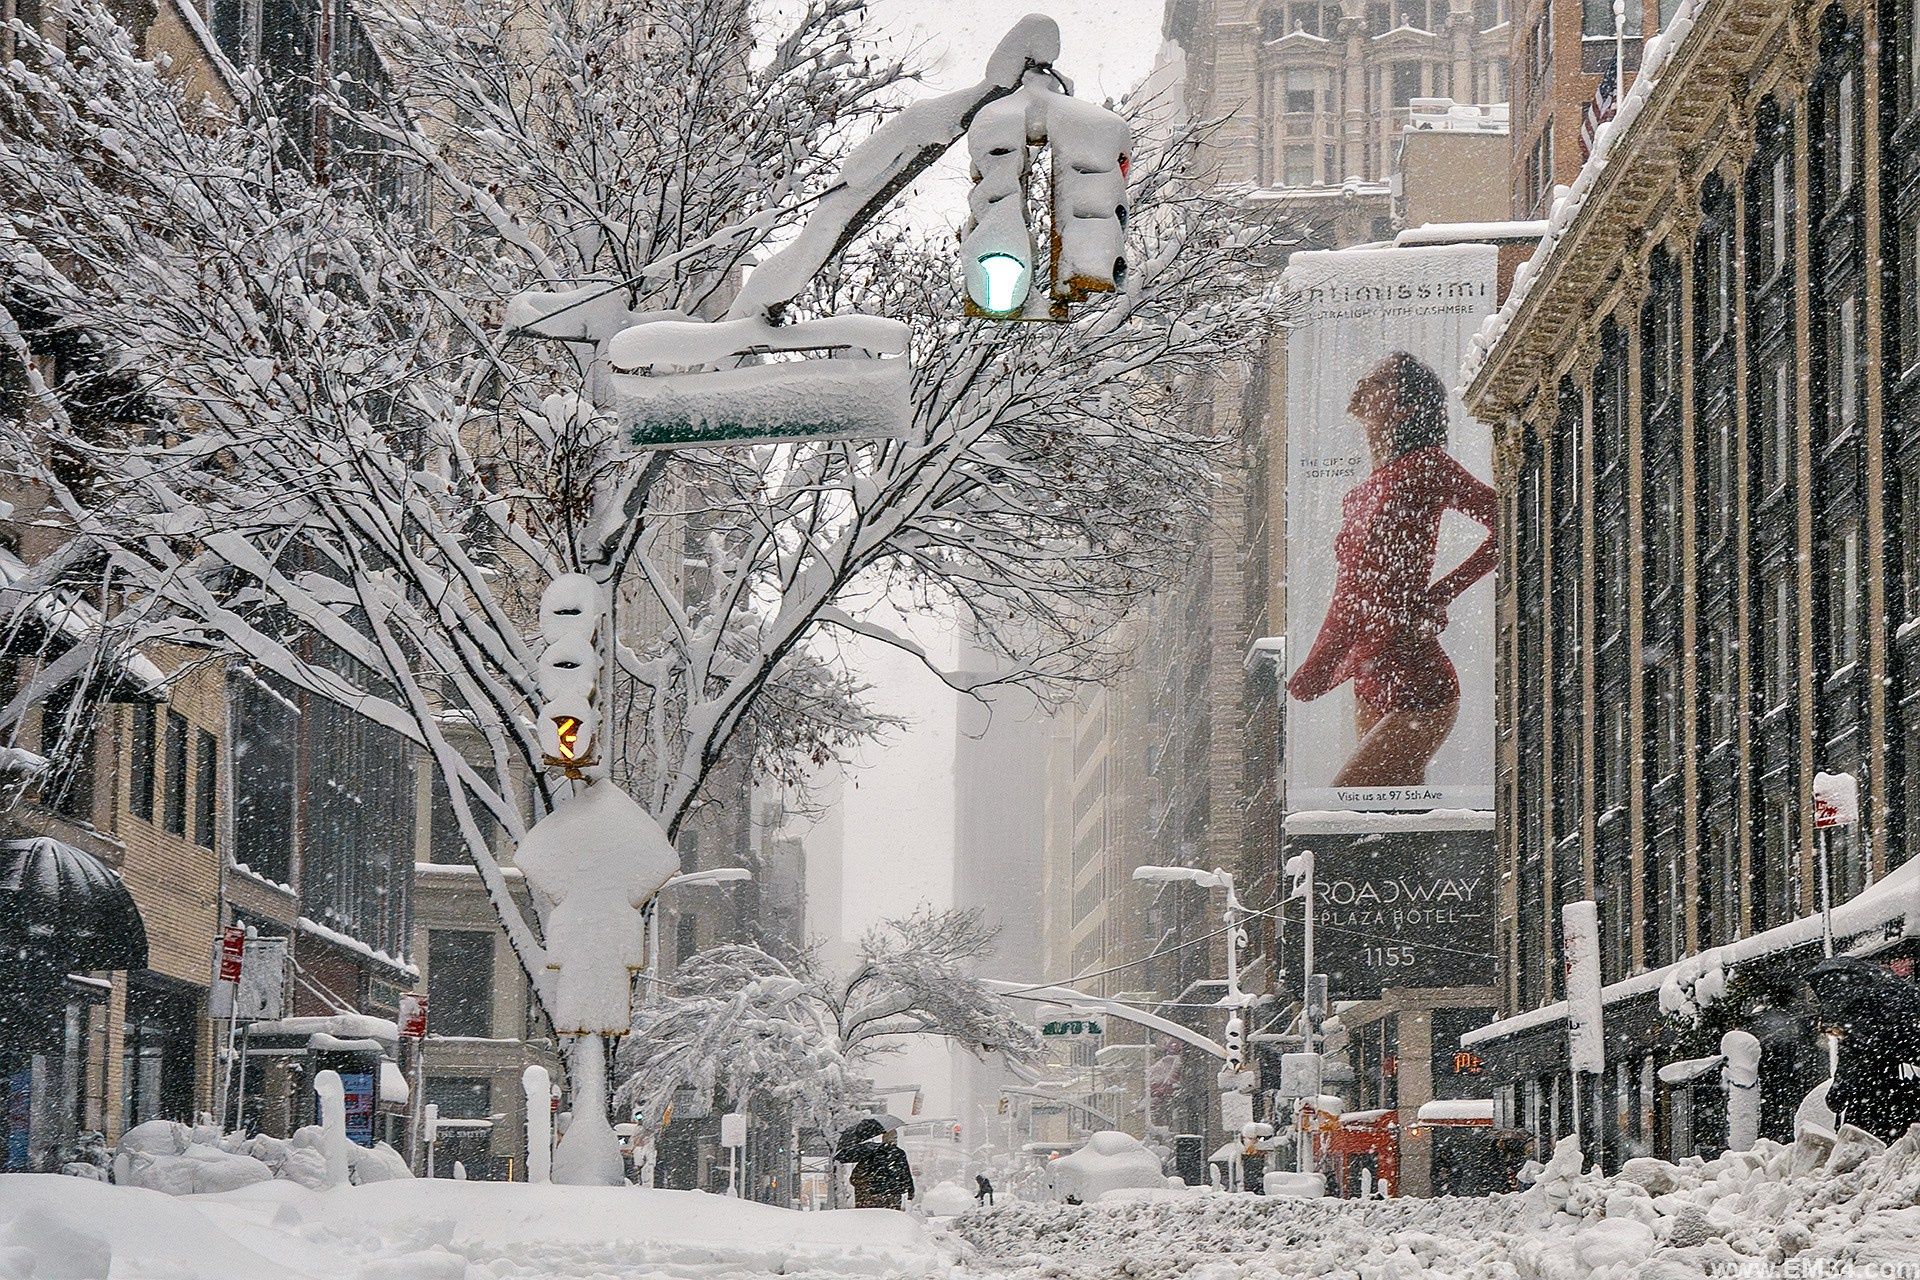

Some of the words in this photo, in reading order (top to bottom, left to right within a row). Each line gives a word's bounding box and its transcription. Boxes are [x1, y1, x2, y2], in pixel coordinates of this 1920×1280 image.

[1299, 282, 1486, 303] ntimissimi
[1415, 304, 1475, 316] CASHMERE
[1337, 791, 1360, 801] Visit
[1362, 793, 1374, 801] us
[1376, 792, 1387, 801] at
[1388, 790, 1402, 800] 97
[1405, 789, 1422, 800] 5th
[1423, 789, 1443, 800] Ave
[1299, 878, 1480, 905] ROADWAY
[1321, 911, 1384, 926] PLAZA
[1394, 908, 1459, 925] HOTEL
[1364, 947, 1415, 967] 1155
